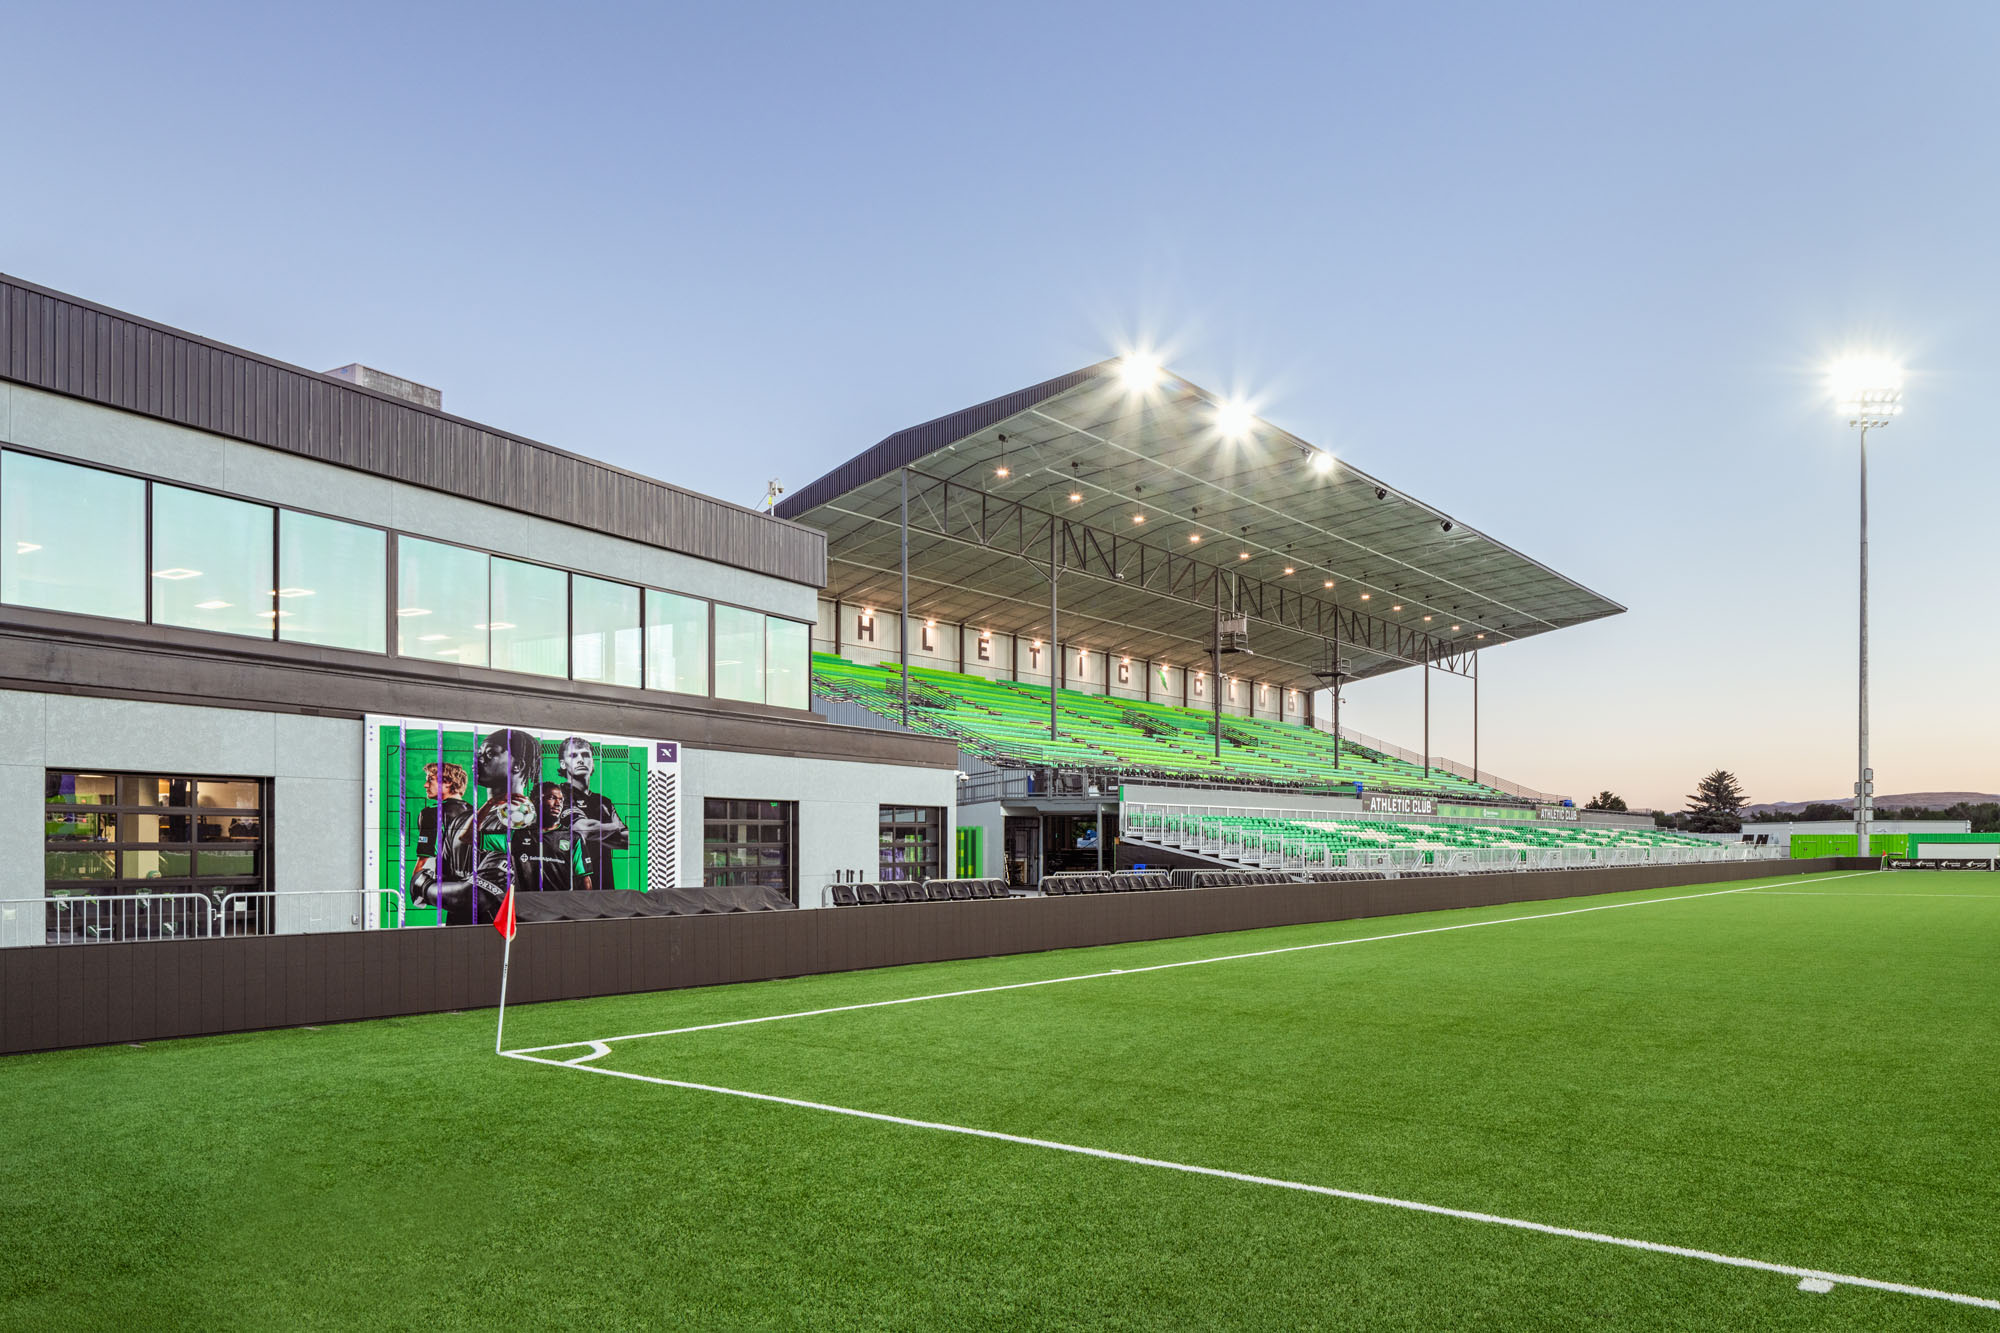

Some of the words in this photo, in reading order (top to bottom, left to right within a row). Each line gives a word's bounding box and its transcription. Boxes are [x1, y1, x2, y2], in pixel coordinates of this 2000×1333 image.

[1370, 797, 1411, 813] ATHLETIC
[1412, 800, 1432, 813] CLUB
[1541, 808, 1564, 820] ATHLETIC
[1565, 810, 1577, 820] CLUB
